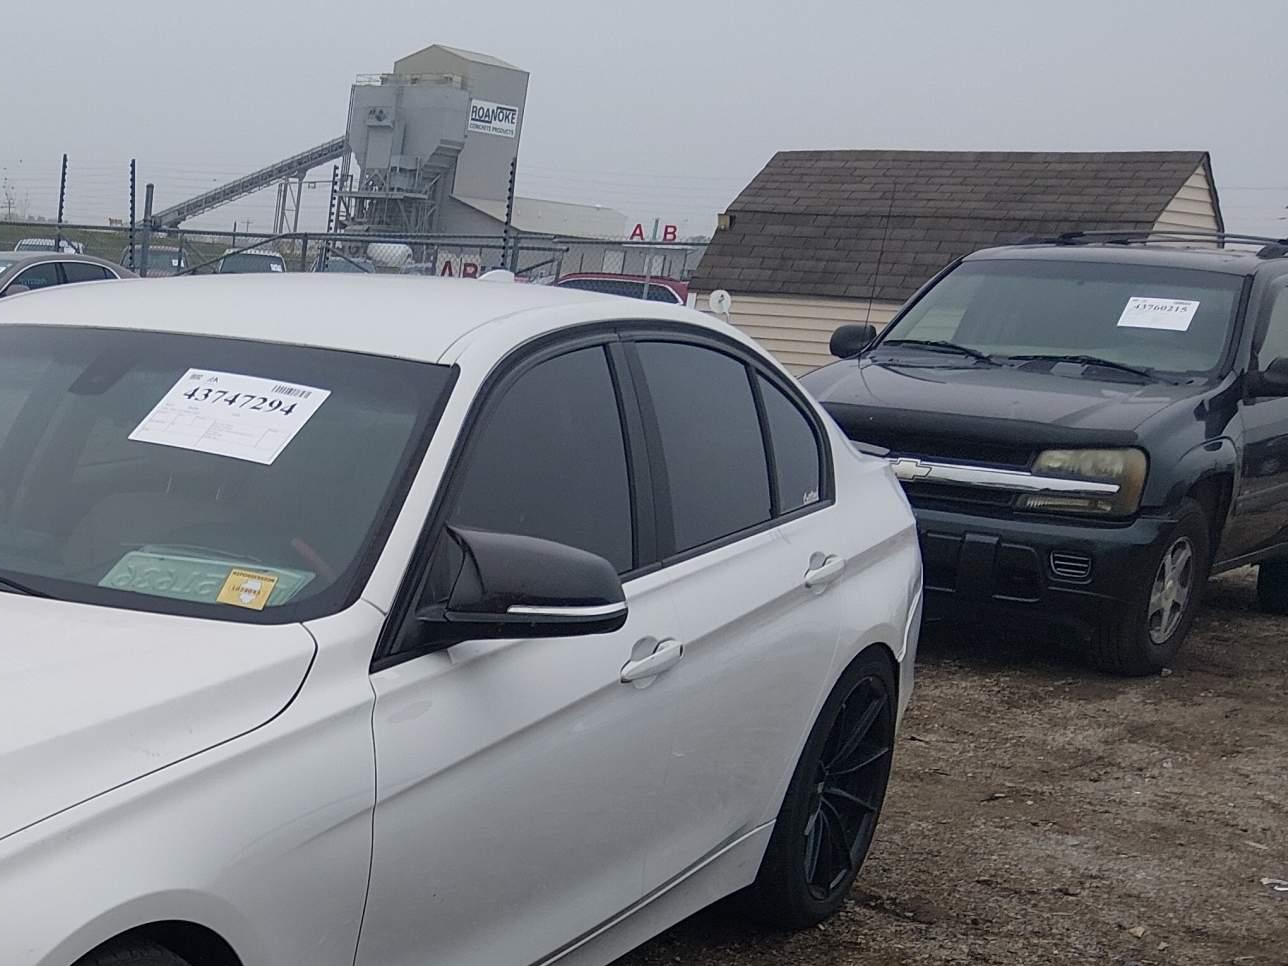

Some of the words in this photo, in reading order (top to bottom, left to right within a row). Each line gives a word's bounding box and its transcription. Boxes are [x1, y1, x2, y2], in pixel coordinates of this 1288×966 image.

[472, 105, 516, 124] ROANOKE
[630, 223, 644, 241] A
[663, 225, 677, 242] B
[183, 386, 298, 416] 43747294
